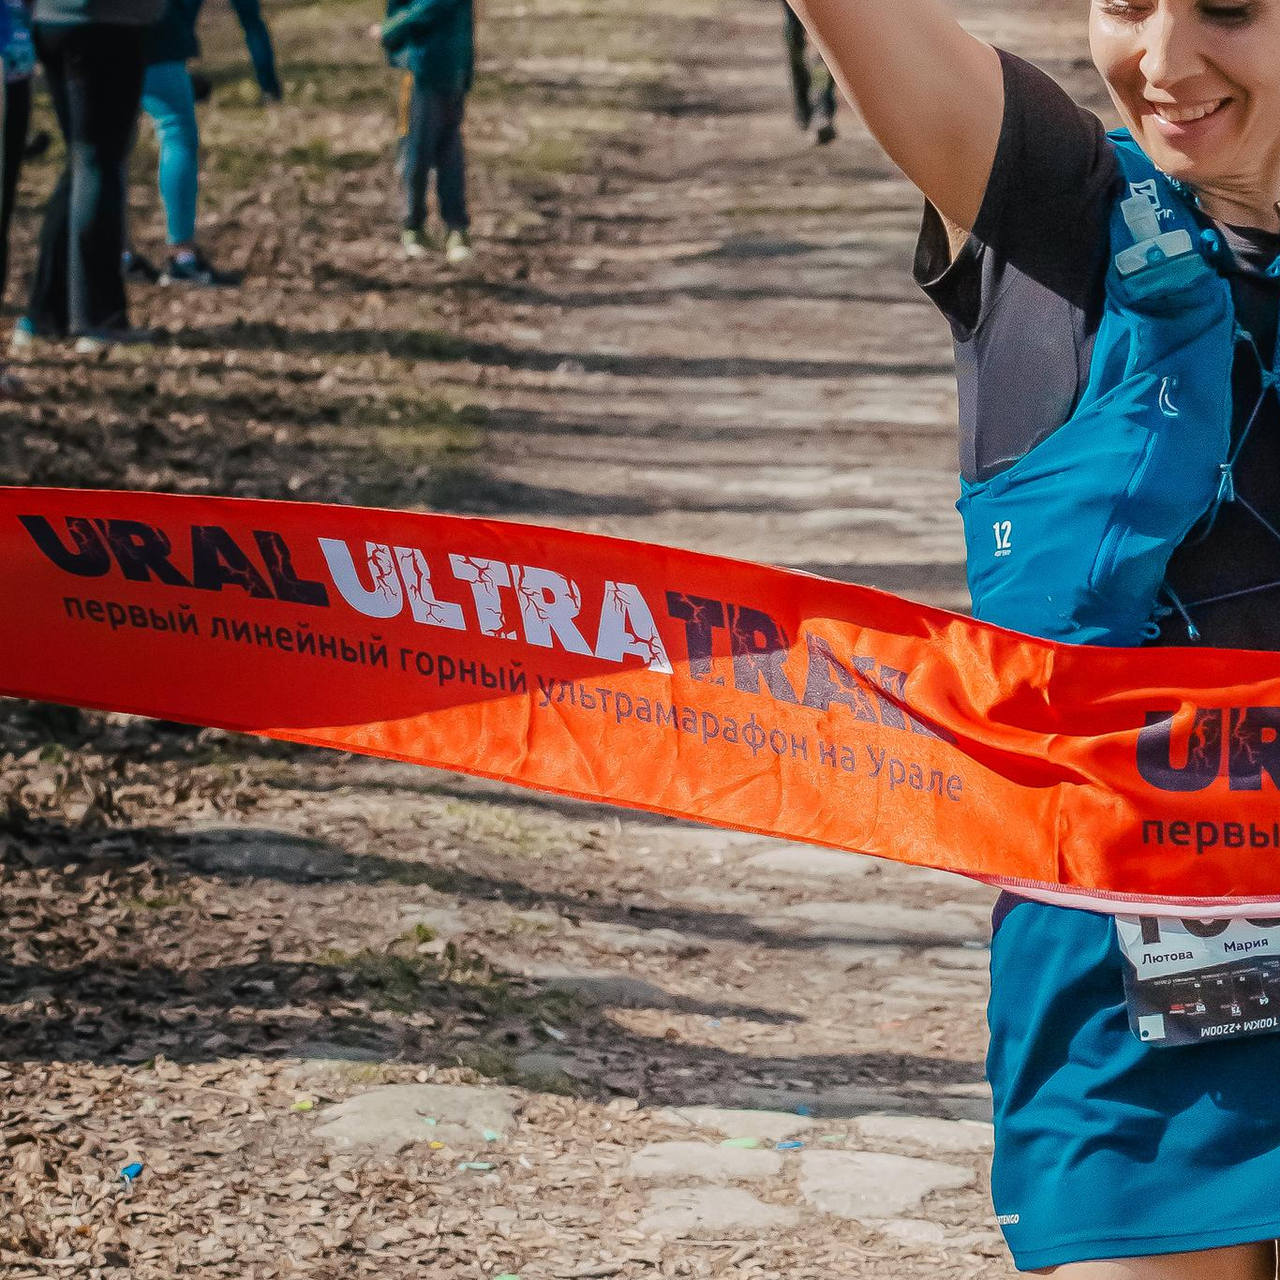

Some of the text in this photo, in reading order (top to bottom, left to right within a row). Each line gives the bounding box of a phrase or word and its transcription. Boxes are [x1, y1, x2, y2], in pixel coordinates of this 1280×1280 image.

[993, 521, 1011, 549] 12
[62, 593, 964, 803] первый линейный горный ультрамарафон на Урале
[1142, 938, 1269, 965] Лютова Мария
